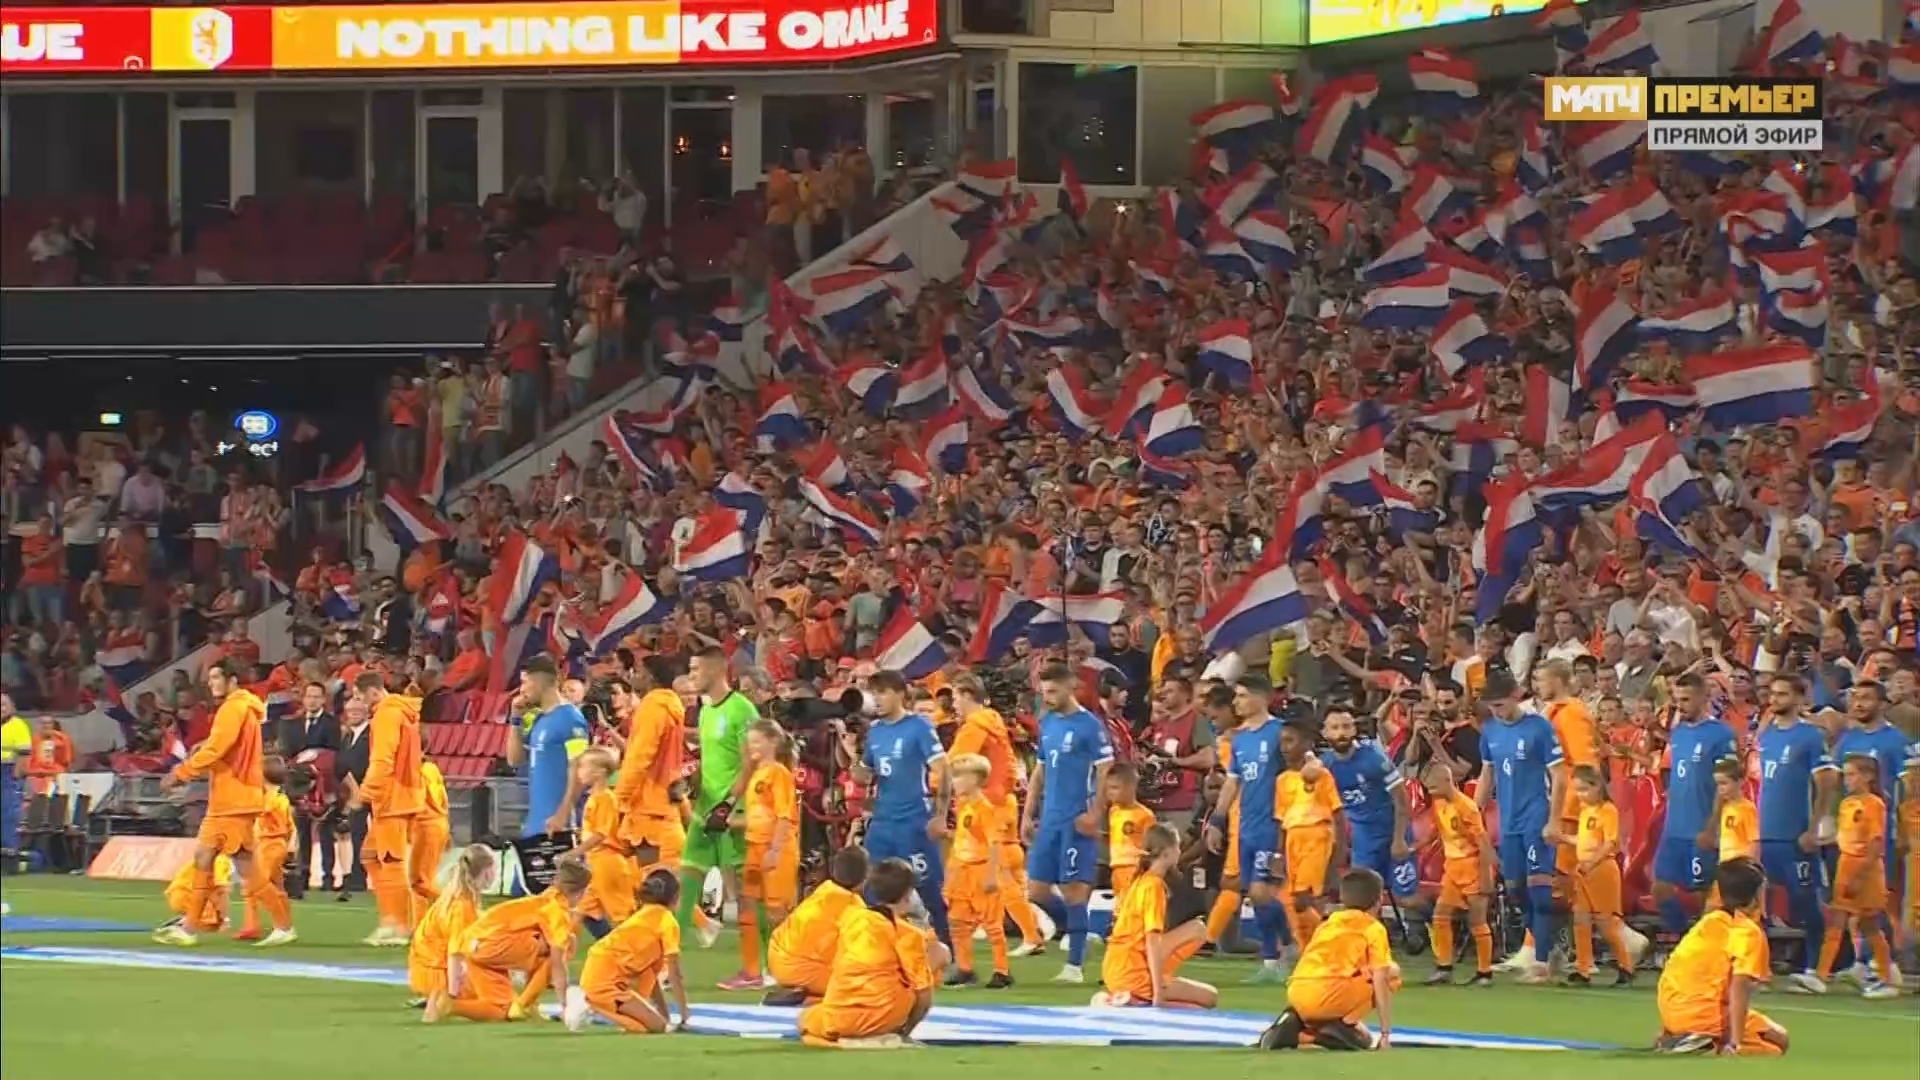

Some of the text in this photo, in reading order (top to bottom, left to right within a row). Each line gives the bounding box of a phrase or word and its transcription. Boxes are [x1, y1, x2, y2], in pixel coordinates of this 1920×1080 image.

[336, 0, 910, 58] NOTHING LIKE ORANJE
[1677, 759, 1687, 778] 6
[1764, 759, 1778, 778] 17
[1066, 847, 1079, 868] 7
[1691, 856, 1703, 876] 6
